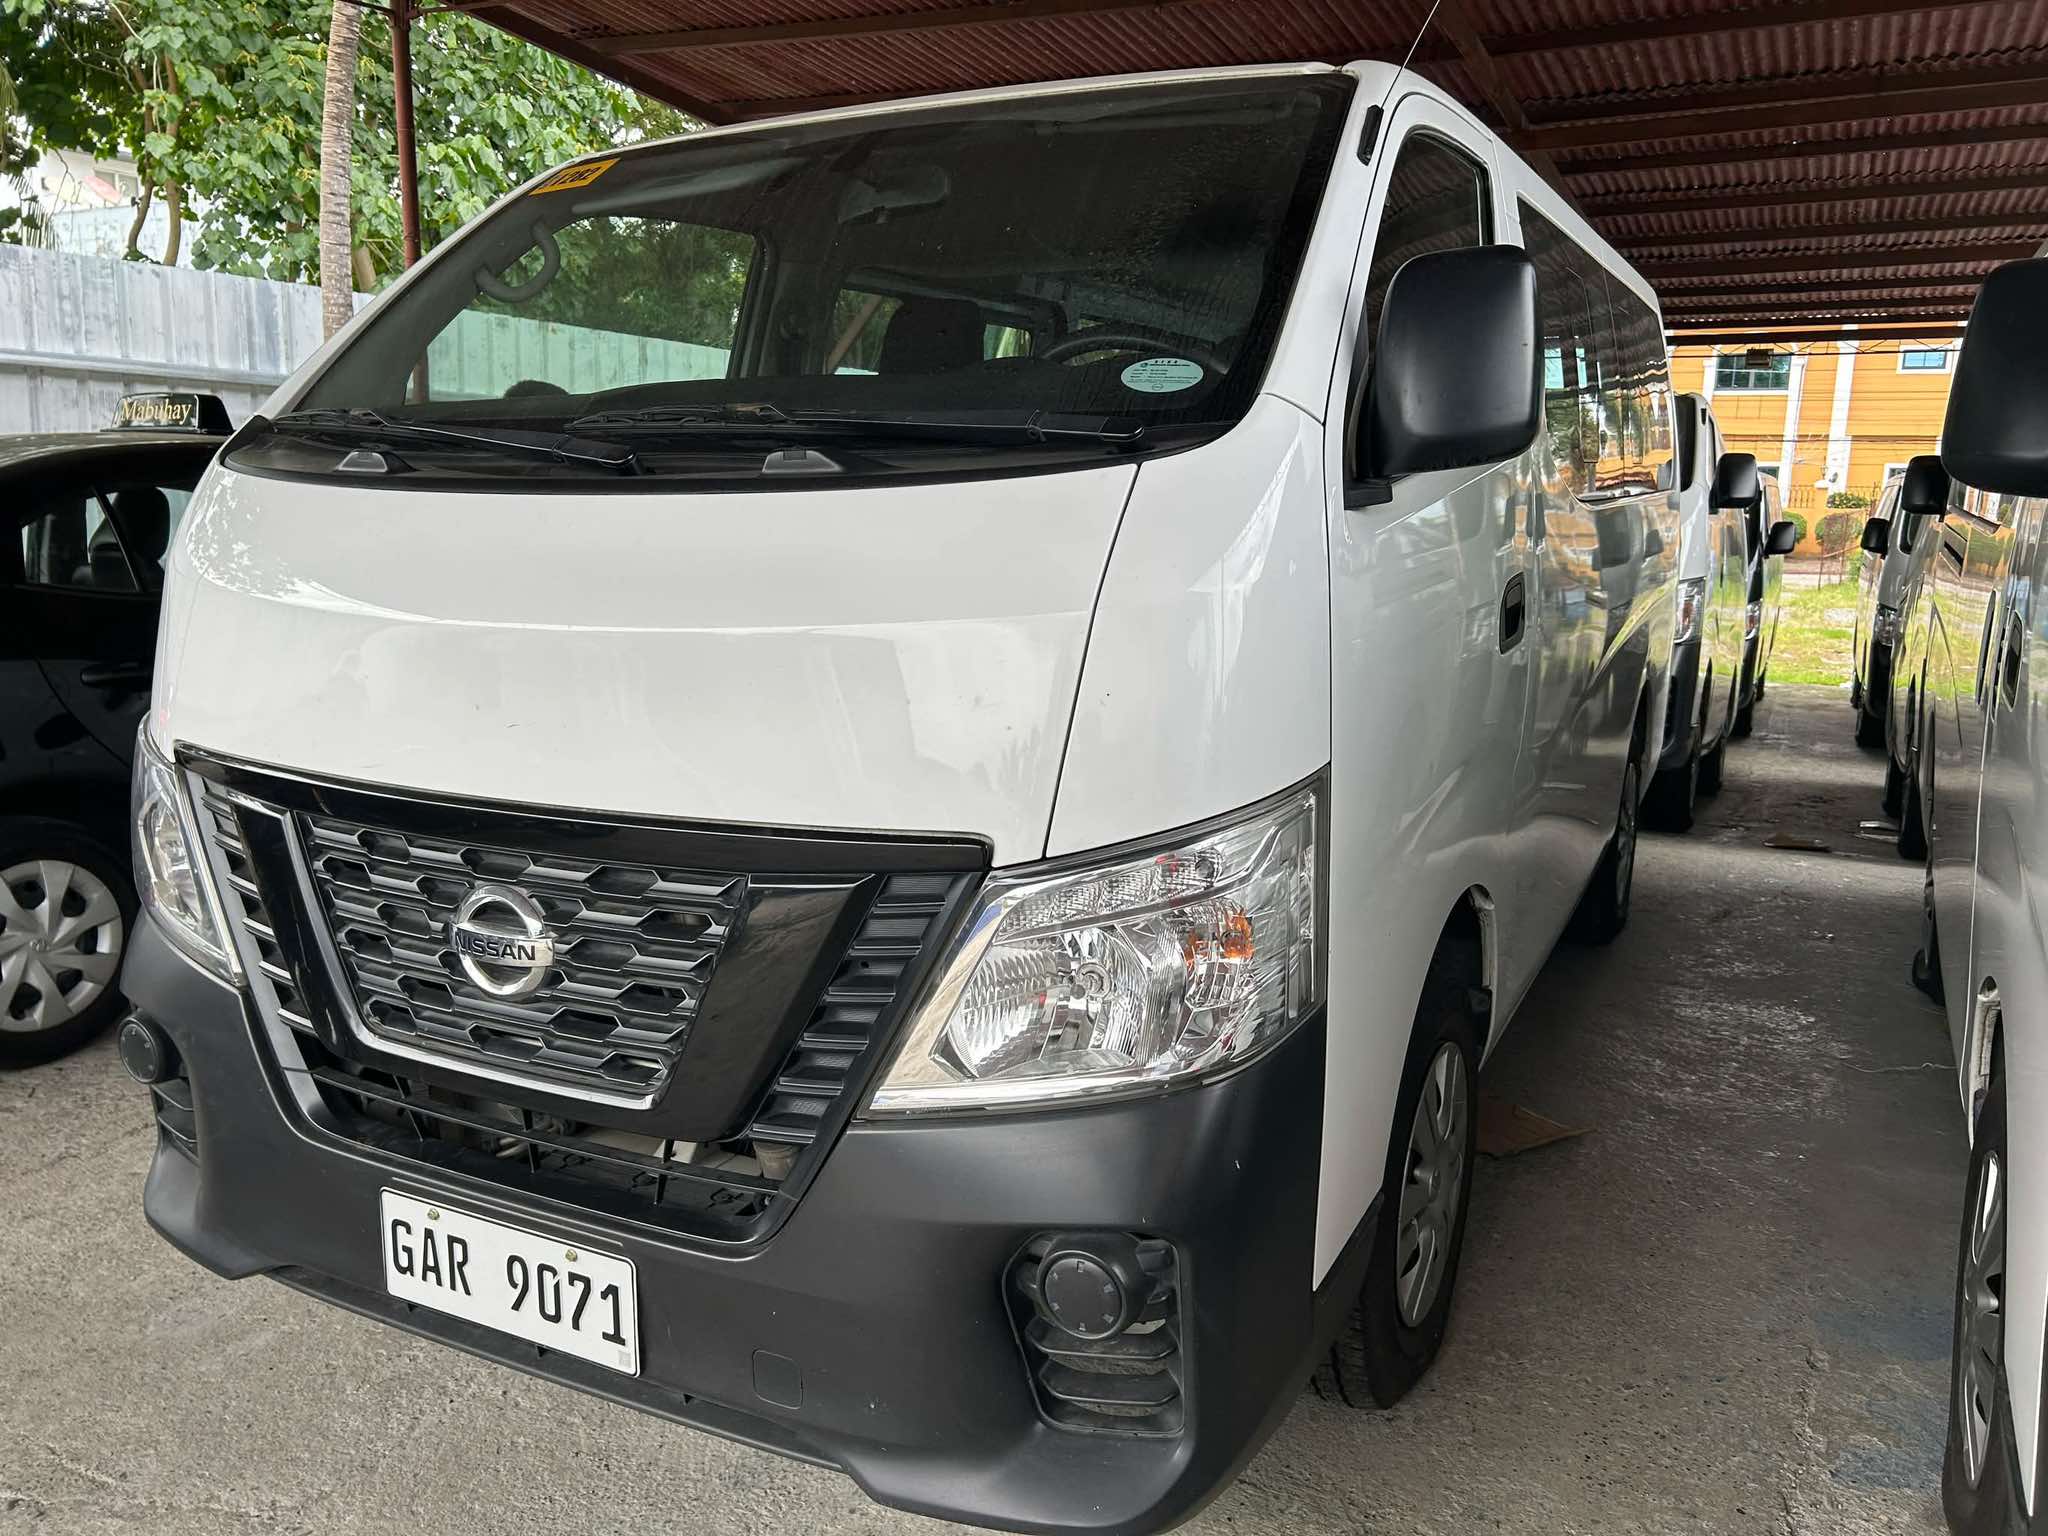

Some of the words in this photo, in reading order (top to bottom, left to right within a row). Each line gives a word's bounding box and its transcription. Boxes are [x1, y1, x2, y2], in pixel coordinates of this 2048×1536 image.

[121, 399, 192, 425] Mabuhay
[455, 930, 536, 961] NISSAN
[391, 1218, 472, 1296] GAR
[506, 1254, 626, 1346] 9071
